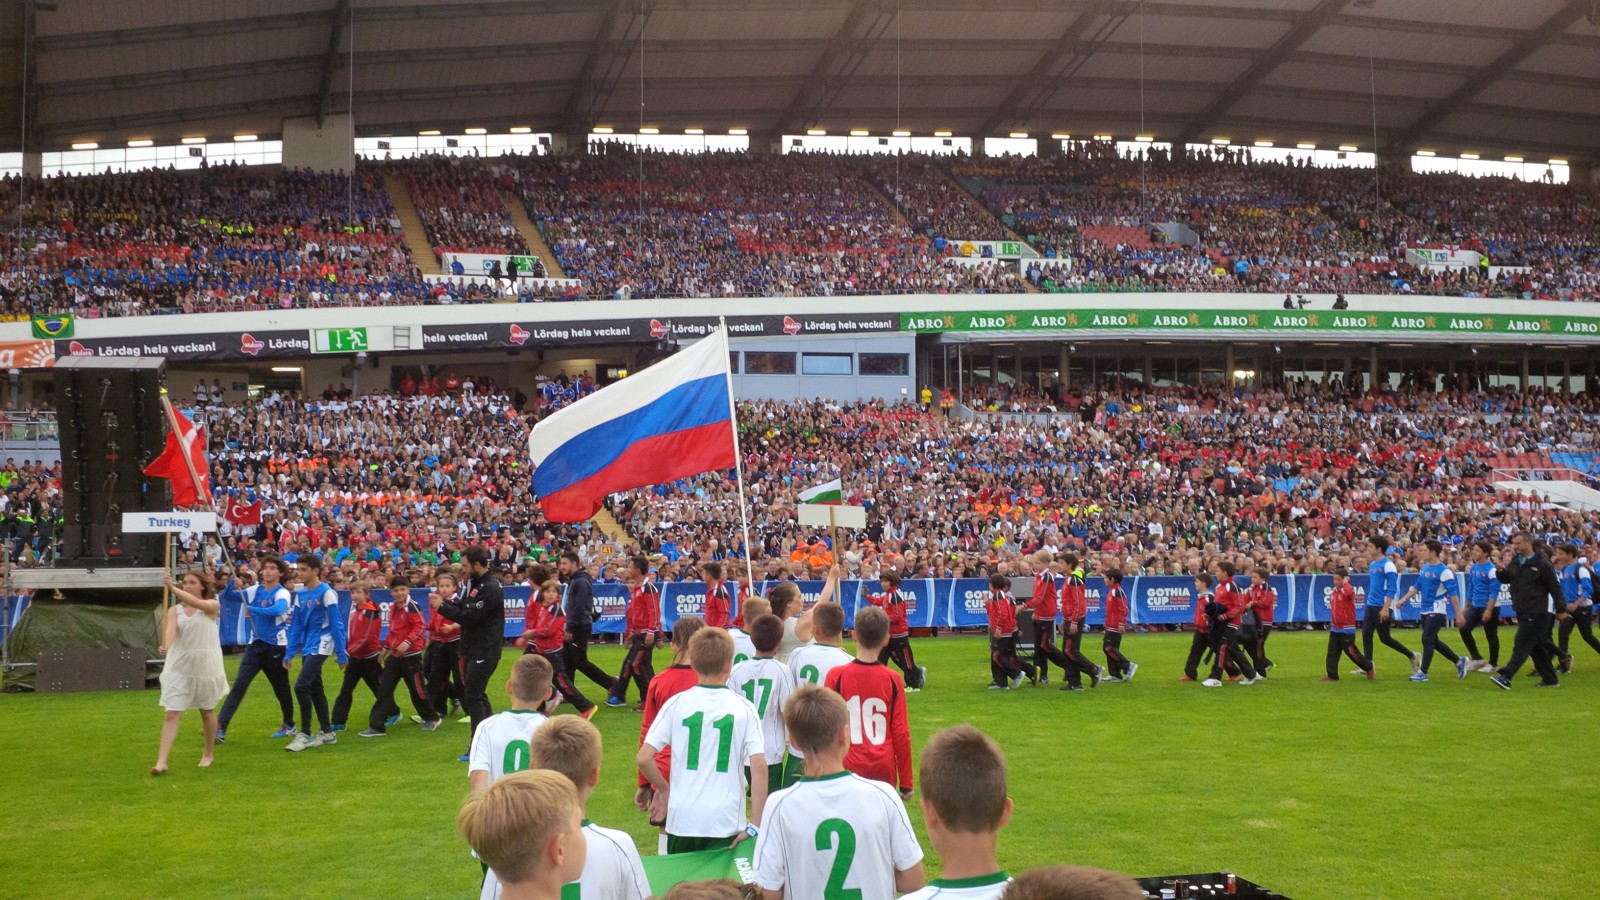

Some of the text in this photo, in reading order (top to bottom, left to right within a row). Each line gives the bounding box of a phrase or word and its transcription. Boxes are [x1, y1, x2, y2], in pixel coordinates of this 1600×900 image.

[672, 324, 706, 334] Lördag
[728, 322, 764, 332] veckan!
[804, 319, 892, 331] Lördag hela veckan!
[423, 331, 488, 343] hela veckan!
[534, 326, 631, 339] Lördag hela veckan!
[98, 341, 216, 357] Lördag hela veckan!
[268, 338, 309, 349] Lördag
[148, 517, 190, 528] Turkey
[1147, 587, 1191, 597] GOTHIA
[1147, 597, 1169, 606] CUP
[676, 603, 699, 613] CUP
[741, 678, 773, 720] 17
[846, 695, 888, 746] 16
[682, 711, 735, 773] 11
[815, 818, 863, 900] 2
